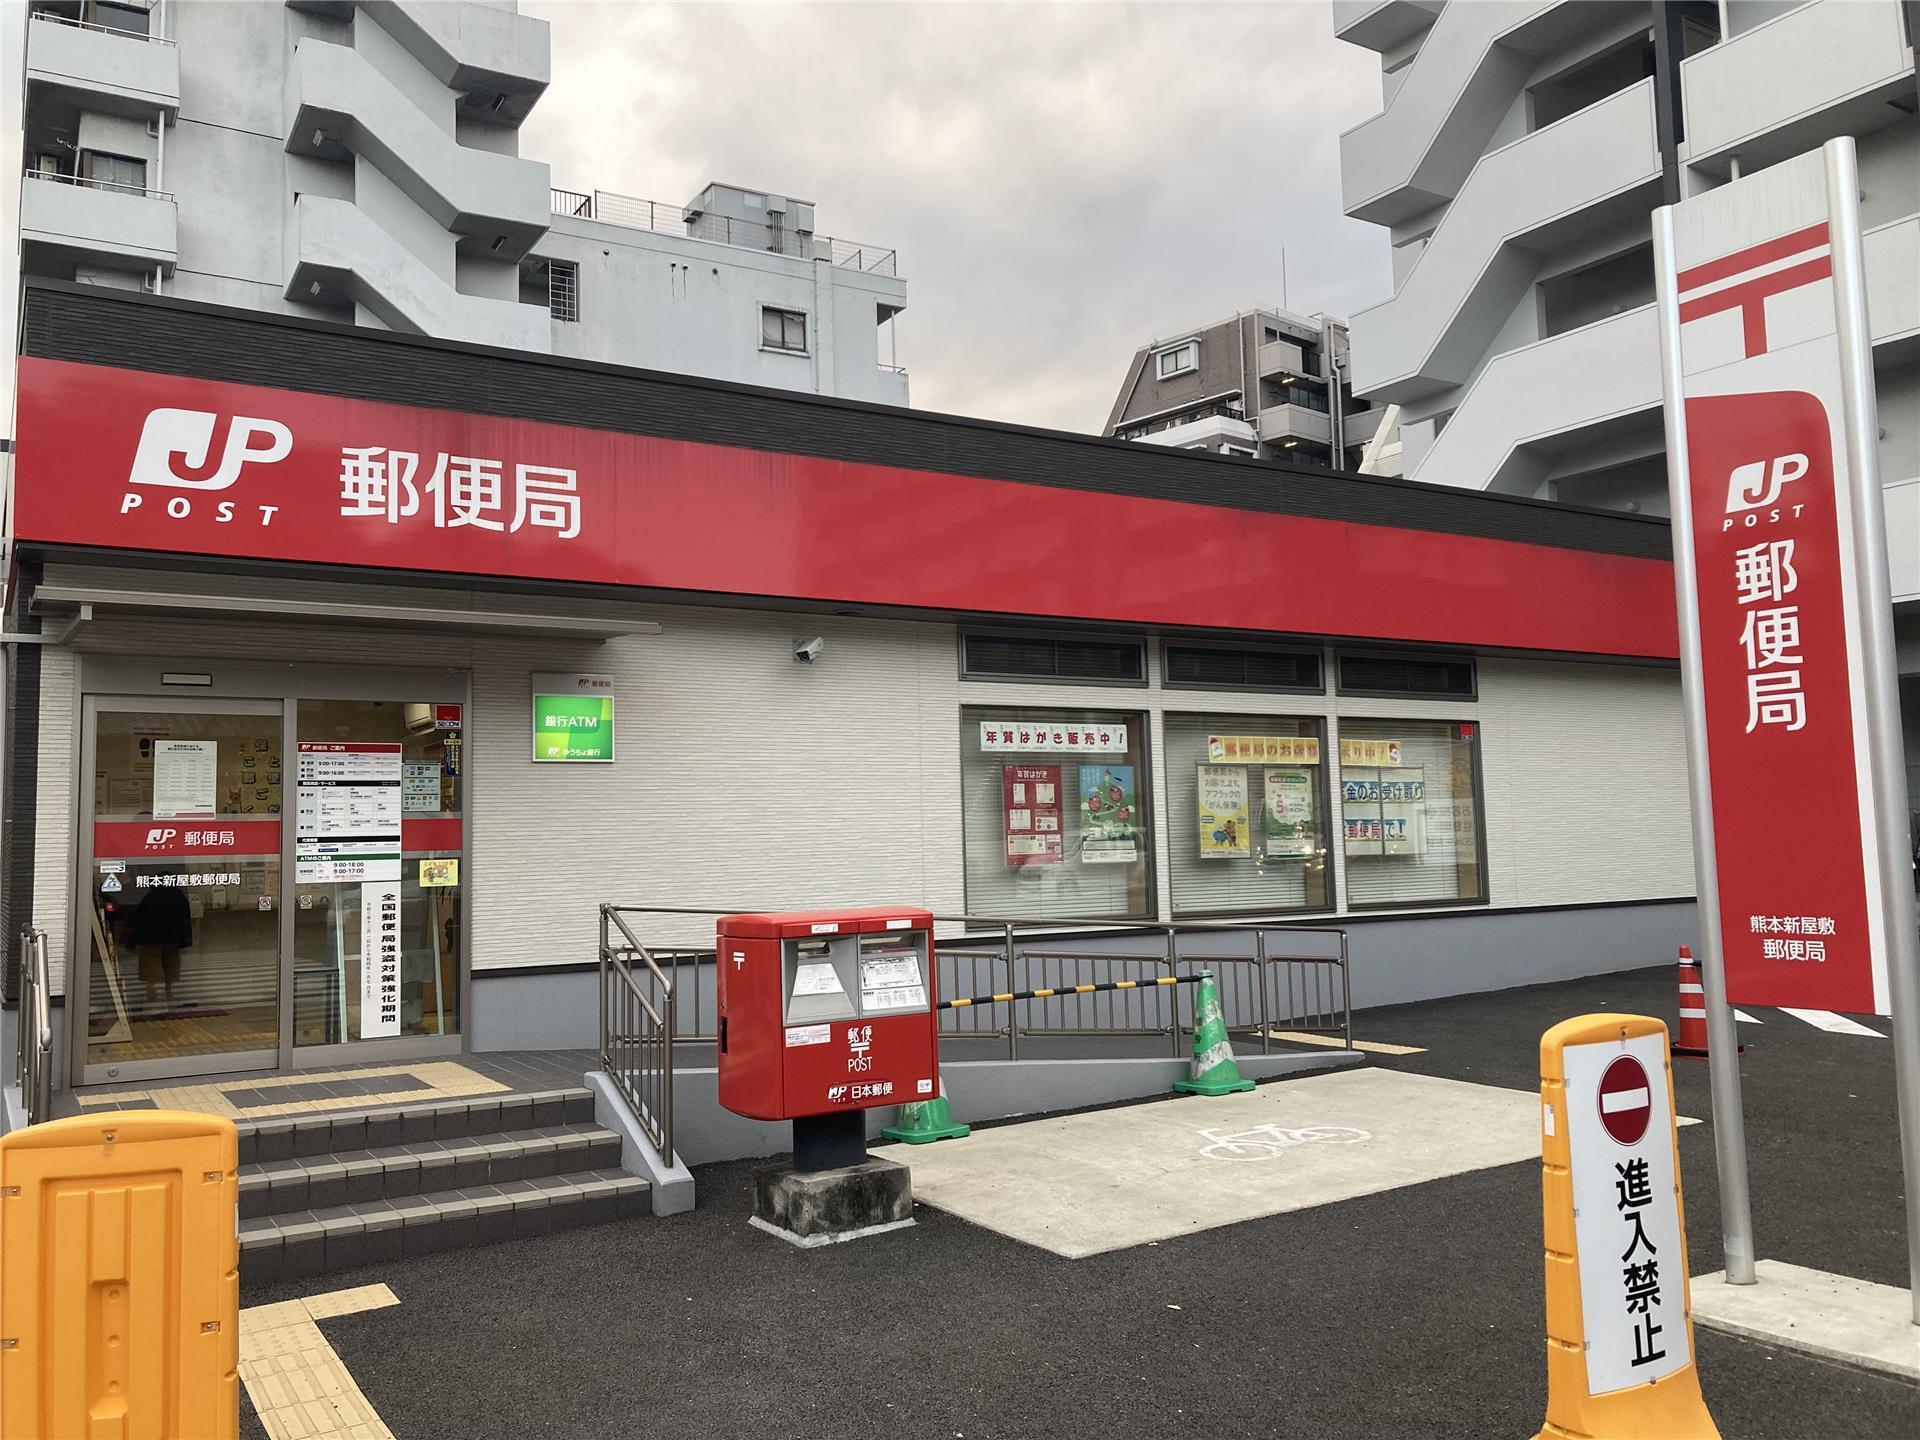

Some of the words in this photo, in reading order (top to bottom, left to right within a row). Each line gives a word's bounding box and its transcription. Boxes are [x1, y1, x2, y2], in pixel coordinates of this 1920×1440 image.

[339, 446, 582, 540] 郵便局
[120, 493, 279, 527] POST
[1723, 503, 1804, 532] POST
[1735, 538, 1808, 735] 郵便局
[545, 715, 597, 728] 銀行ATM
[986, 731, 1124, 745] 年賀はがき販売中!
[563, 748, 601, 756] ゆうちょ銀行
[1017, 770, 1048, 779] 年賀はがき
[1342, 785, 1424, 800] 金のお受け取り
[184, 831, 235, 846] 郵便局
[136, 872, 241, 888] 熊本新屋敷郵便局
[1750, 914, 1836, 935] 熊本新屋敷
[381, 893, 396, 1023] 全国郵便局強盗対策強化期間
[1763, 938, 1826, 963] 郵便局
[848, 1026, 872, 1043] 郵便
[848, 1057, 872, 1072] POST
[851, 1082, 893, 1098] 日本郵便
[1615, 1157, 1665, 1367] 進入禁止
